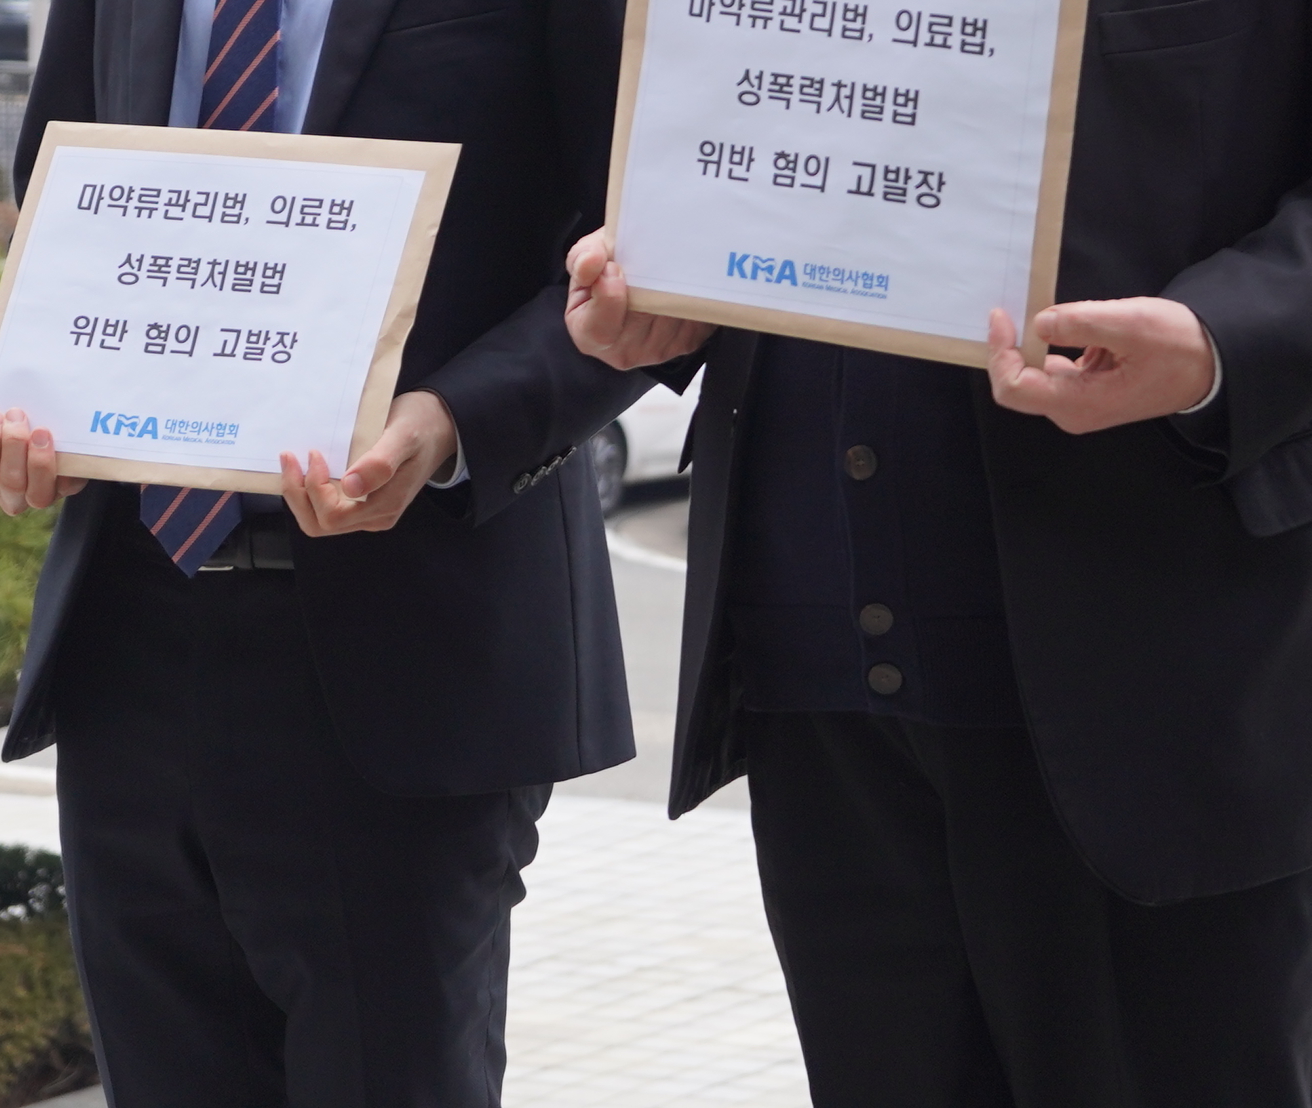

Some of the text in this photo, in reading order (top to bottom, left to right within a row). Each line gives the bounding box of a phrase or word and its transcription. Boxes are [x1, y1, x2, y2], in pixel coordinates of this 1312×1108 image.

[892, 9, 995, 57] 의료법,
[736, 69, 920, 126] 성폭력처벌법
[696, 140, 946, 209] 위반 혐의 고발장
[76, 184, 357, 232] 마약류관리법, 의료법,
[117, 253, 287, 295] 성폭력처벌법
[727, 252, 798, 286] KMA
[803, 263, 889, 291] 대한의사협회
[69, 315, 299, 364] 위반 혐의 고발장
[90, 411, 158, 439] KMA
[165, 419, 239, 438] 대한의사협회
